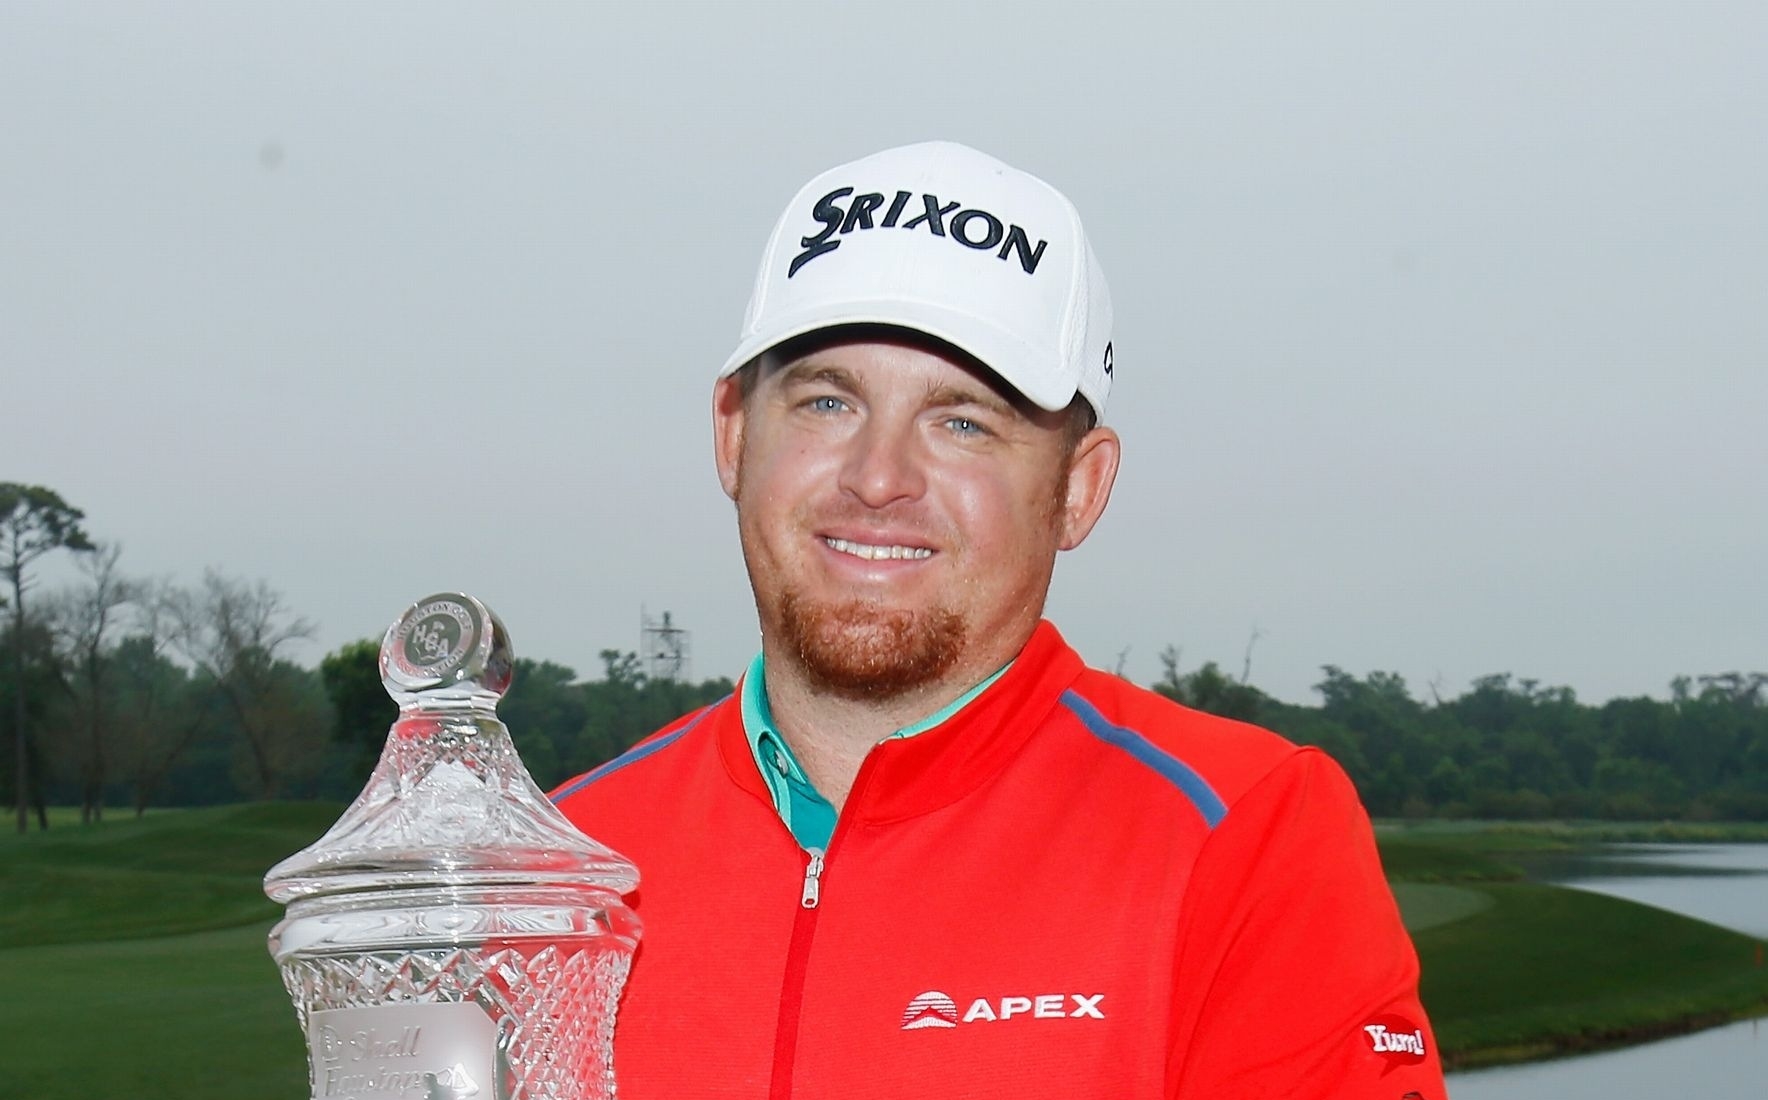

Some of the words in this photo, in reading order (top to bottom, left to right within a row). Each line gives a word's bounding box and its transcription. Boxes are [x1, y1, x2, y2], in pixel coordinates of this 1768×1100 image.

[788, 186, 1049, 279] SRIXON
[962, 993, 1106, 1023] APEX
[351, 1025, 422, 1061] Shell
[1363, 1024, 1426, 1056] Yum!
